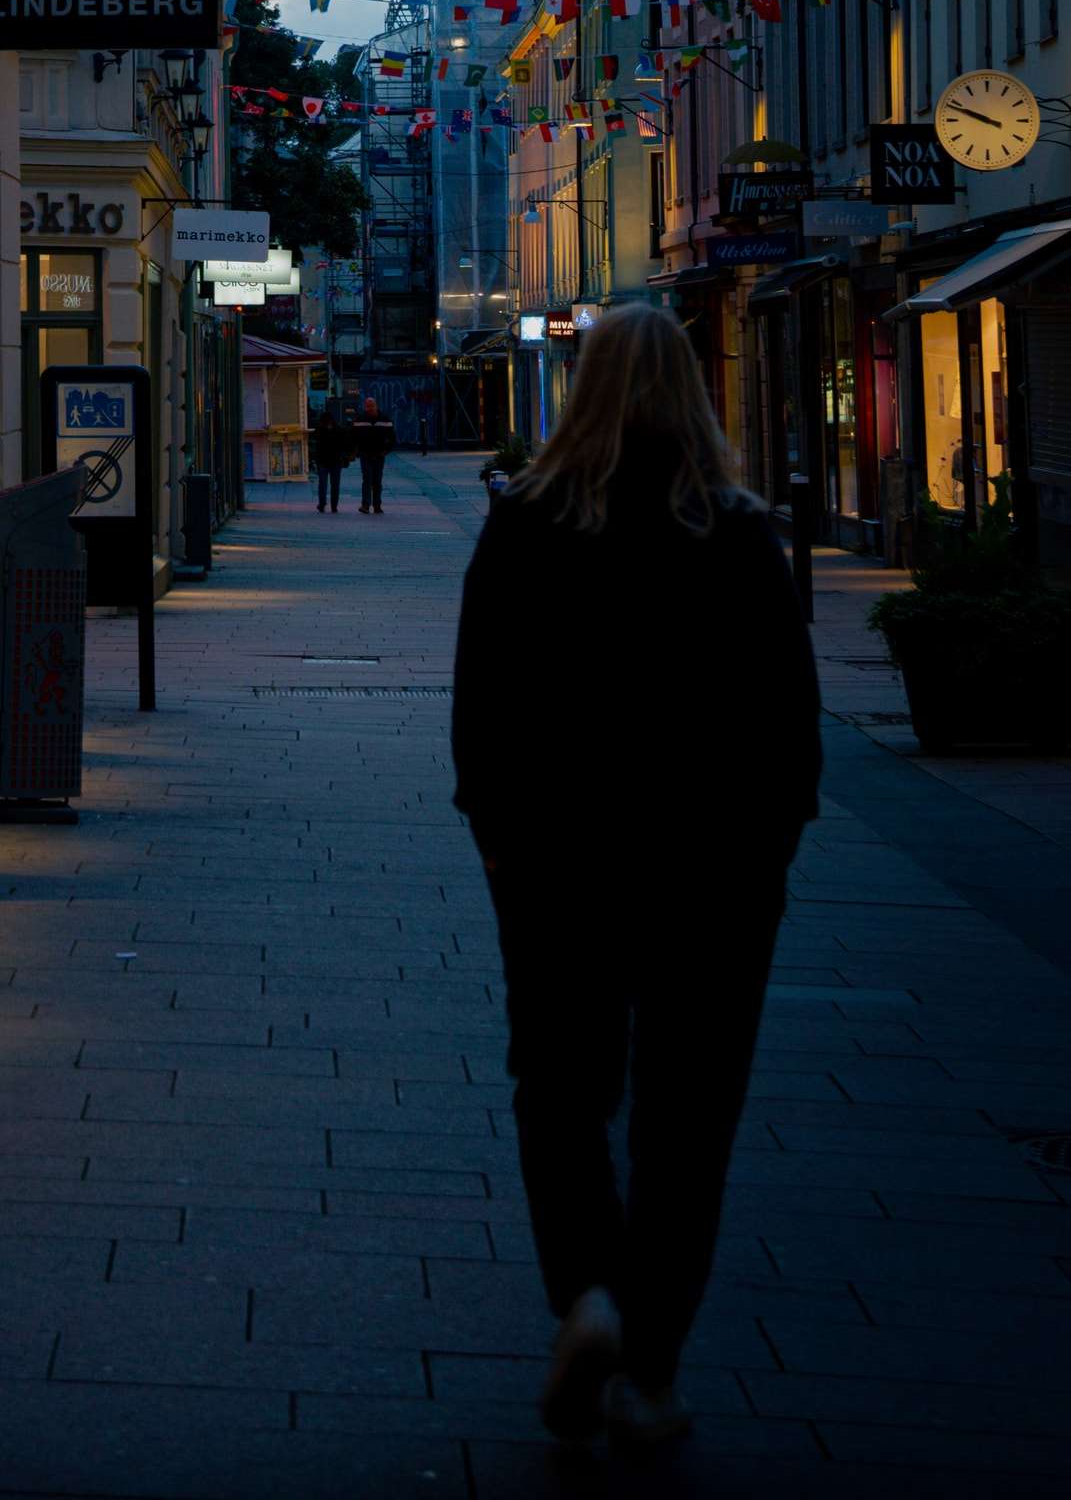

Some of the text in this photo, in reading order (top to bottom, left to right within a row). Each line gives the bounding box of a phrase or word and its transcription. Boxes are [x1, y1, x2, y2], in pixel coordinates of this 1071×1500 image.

[882, 140, 942, 163] NOA
[882, 165, 942, 188] NOA
[177, 229, 266, 244] marimekko
[548, 321, 574, 330] MIVA
